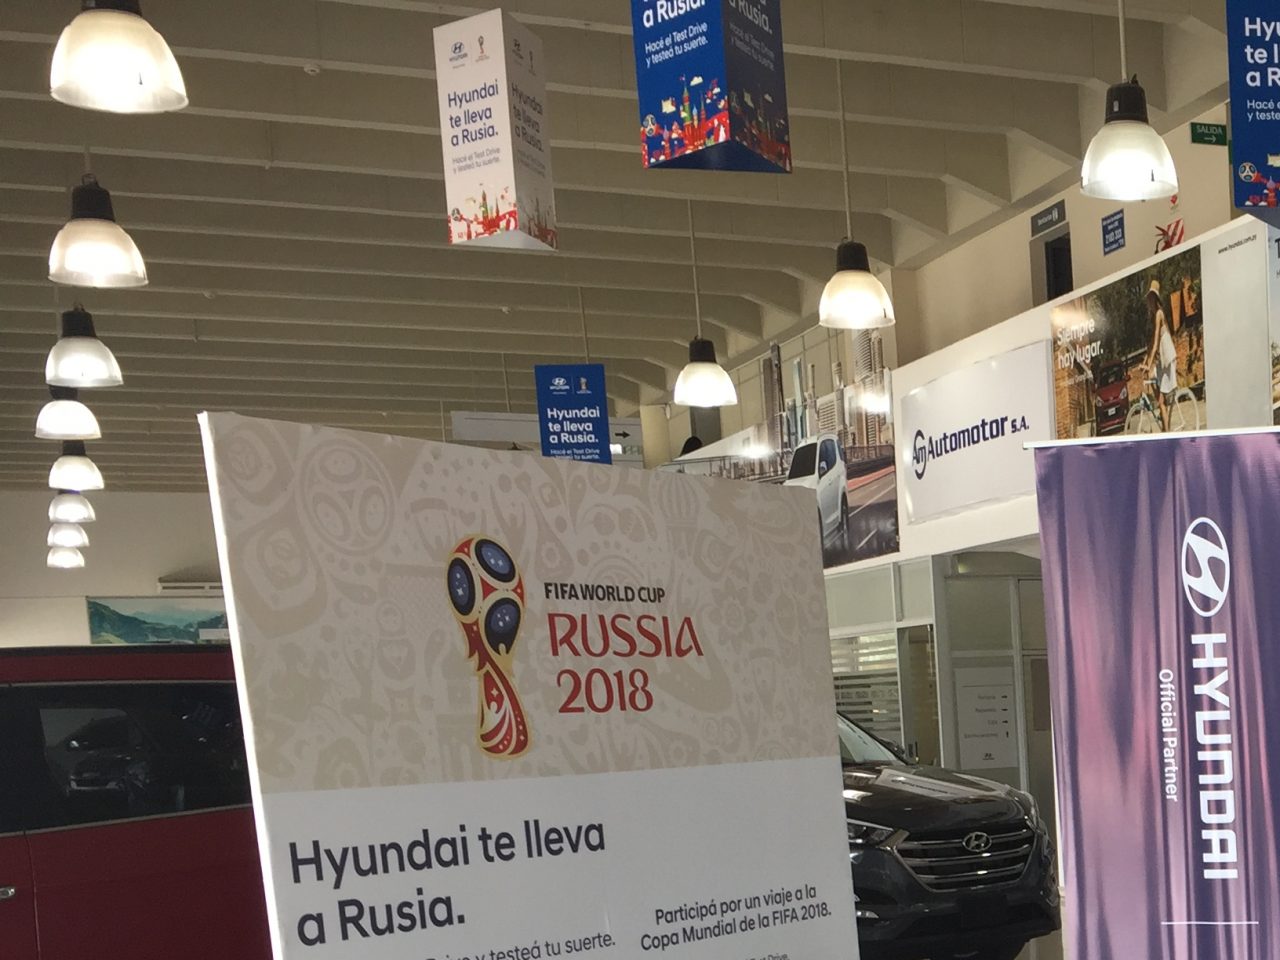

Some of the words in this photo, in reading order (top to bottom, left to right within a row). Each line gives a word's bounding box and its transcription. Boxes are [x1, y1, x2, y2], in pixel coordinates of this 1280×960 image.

[643, 9, 654, 28] a
[1244, 45, 1268, 64] te
[1246, 70, 1261, 87] a
[448, 78, 499, 109] Hyundai
[1247, 99, 1275, 109] Hacé
[449, 114, 462, 129] te
[464, 107, 492, 126] lleva
[1196, 125, 1223, 135] SALIDA
[1247, 112, 1254, 122] y
[451, 134, 459, 147] a
[461, 122, 499, 144] Rusia.
[1057, 317, 1095, 346] Siempre
[1058, 351, 1075, 371] hay
[1076, 340, 1104, 365] lugar.
[547, 406, 600, 421] Hyundai
[548, 421, 561, 432] te
[563, 420, 593, 432] lleva
[549, 434, 558, 443] a
[560, 431, 599, 443] Rusia.
[928, 416, 1008, 461] Automotor
[544, 581, 580, 601] FIFA
[580, 584, 636, 603] WORLD
[638, 586, 666, 604] CUP
[547, 612, 704, 658] RUSSIA
[556, 668, 654, 714] 2018
[1158, 668, 1176, 732] Official
[1162, 735, 1178, 802] Partner
[1191, 632, 1238, 879] HYUNDAI
[289, 824, 469, 890] Hyundai
[477, 826, 516, 863] te
[523, 819, 606, 859] lleva
[297, 912, 326, 946] a
[337, 887, 466, 941] Rusia.
[655, 899, 717, 926] Participá
[720, 898, 742, 917] por
[744, 894, 761, 910] un
[763, 886, 792, 908] viaje
[795, 887, 803, 901] a
[805, 883, 817, 899] la
[640, 929, 680, 951] Copa
[682, 918, 737, 944] Mundial
[739, 914, 756, 933] de
[758, 912, 770, 929] la
[772, 907, 799, 926] FIFA
[801, 902, 832, 921] 2018.
[544, 940, 561, 957] tu
[564, 931, 617, 954] suerte.
